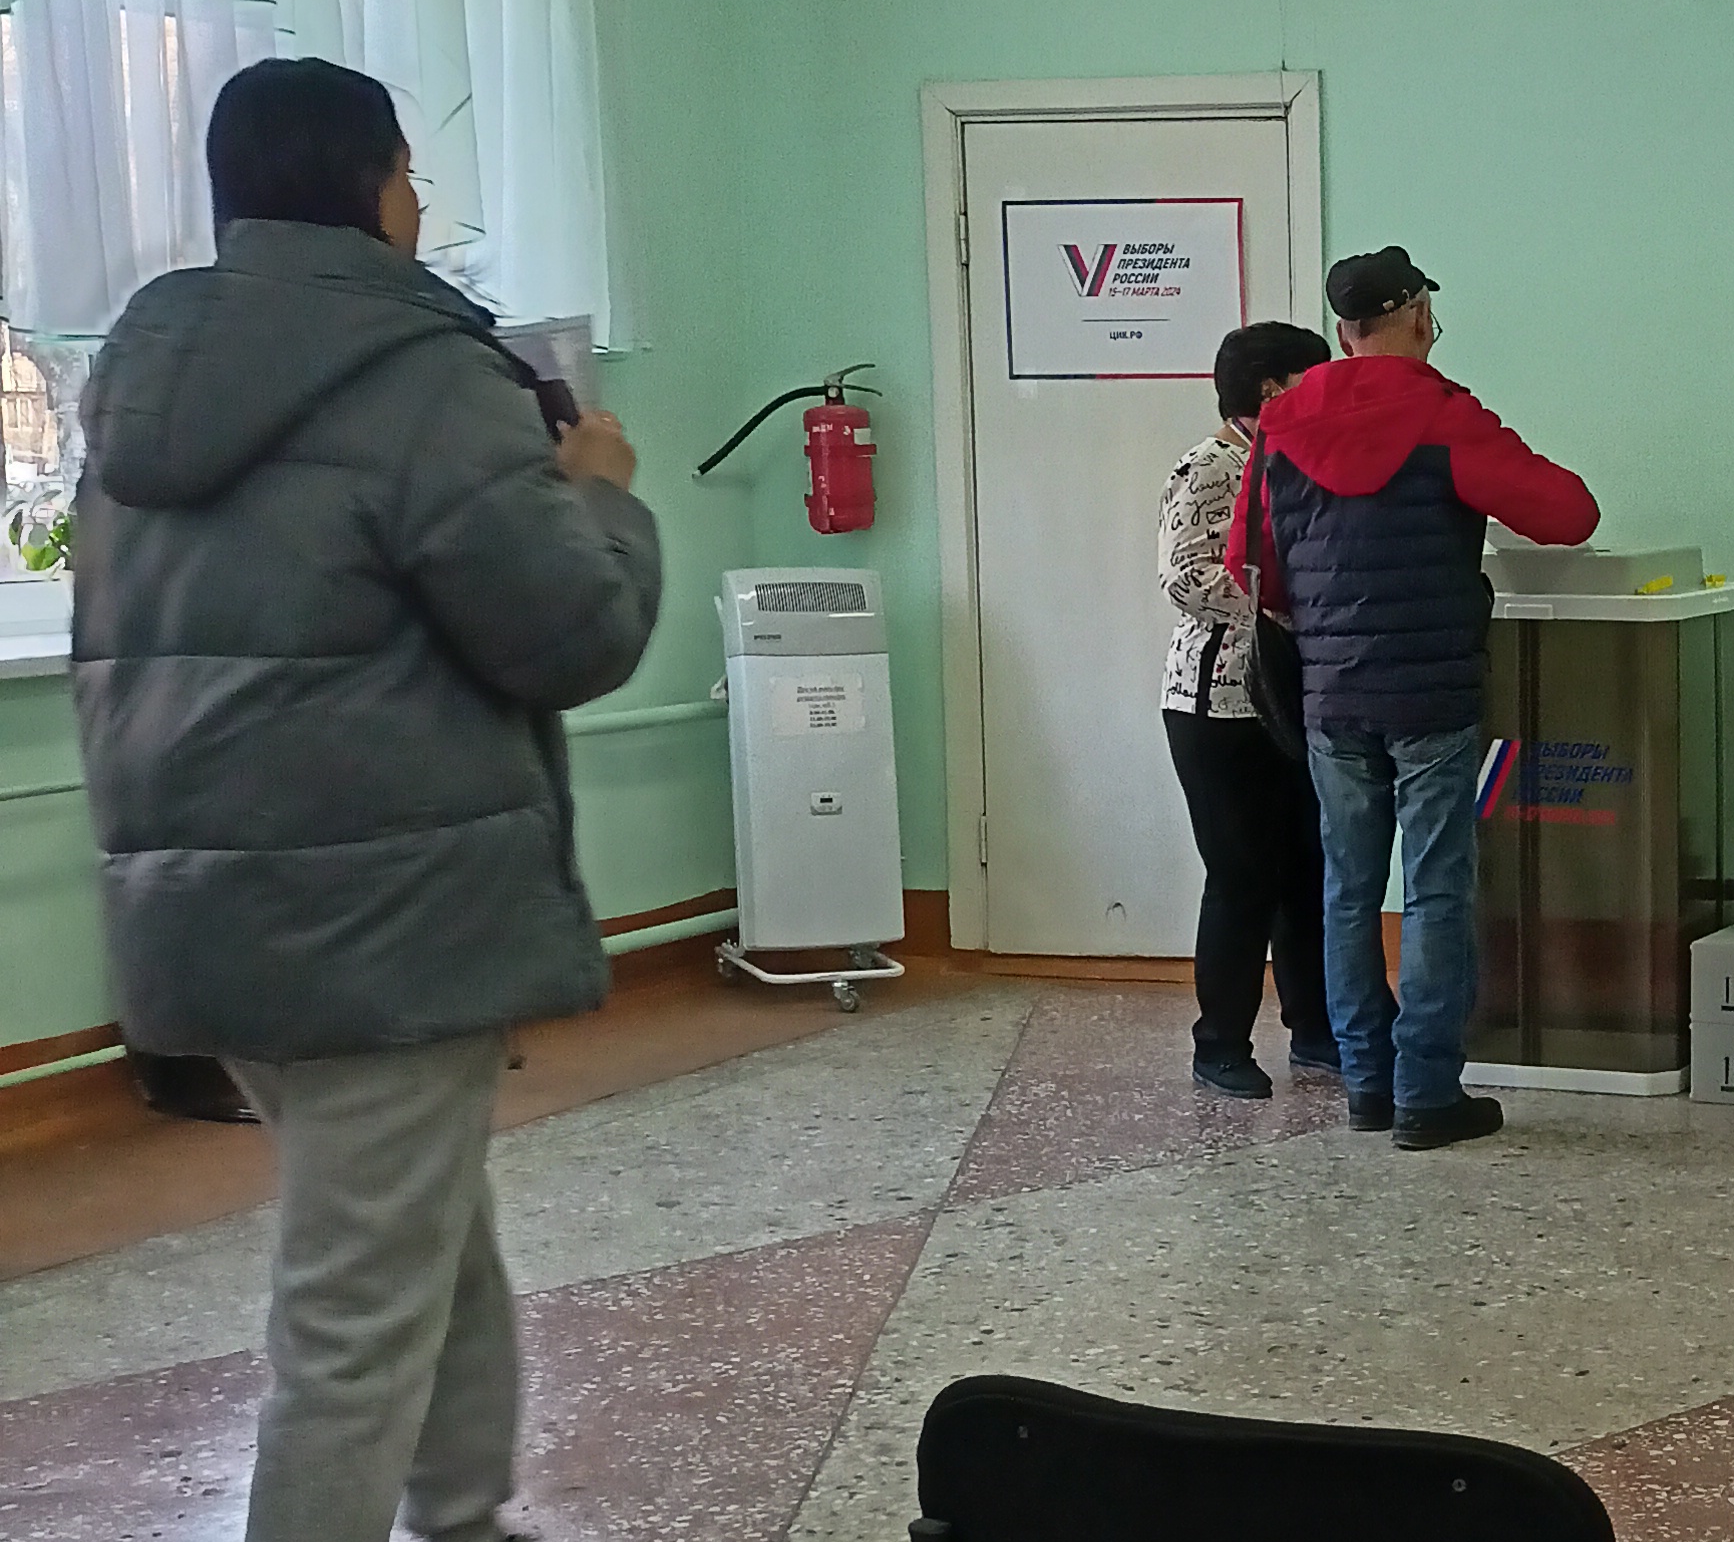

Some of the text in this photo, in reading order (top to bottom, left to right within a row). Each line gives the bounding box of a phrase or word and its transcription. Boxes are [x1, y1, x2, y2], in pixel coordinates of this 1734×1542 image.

[1122, 243, 1175, 255] ВЫБОРЫ
[1117, 258, 1190, 270] ПРЕЗИДЕНТА
[1112, 273, 1159, 284] РОССИИ
[1131, 287, 1160, 296] МАРТА
[1160, 287, 1181, 296] 2024
[1109, 331, 1143, 341] ЦИК.РФ
[1525, 763, 1633, 784] РЕЗИДЕНТА
